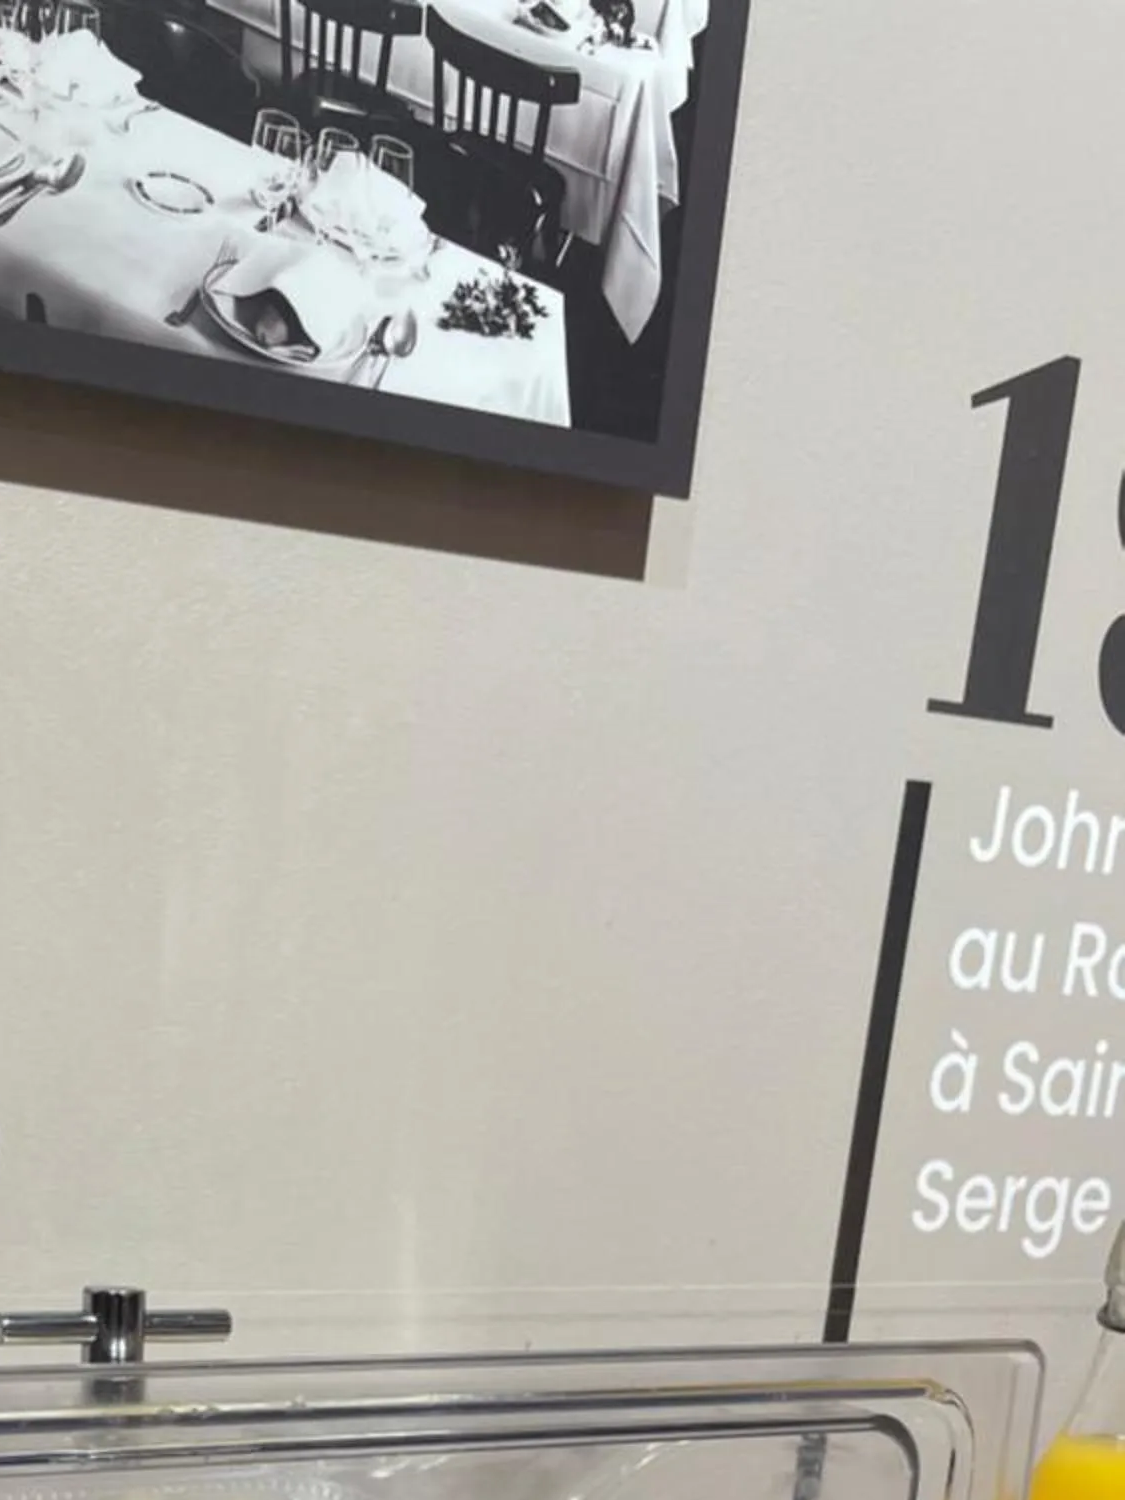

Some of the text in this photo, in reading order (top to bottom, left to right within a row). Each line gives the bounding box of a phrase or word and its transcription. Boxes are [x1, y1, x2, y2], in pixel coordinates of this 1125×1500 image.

[927, 355, 1125, 740] 1
[949, 928, 1045, 993] au
[930, 1027, 978, 1113] à
[911, 1159, 1111, 1259] Serge
